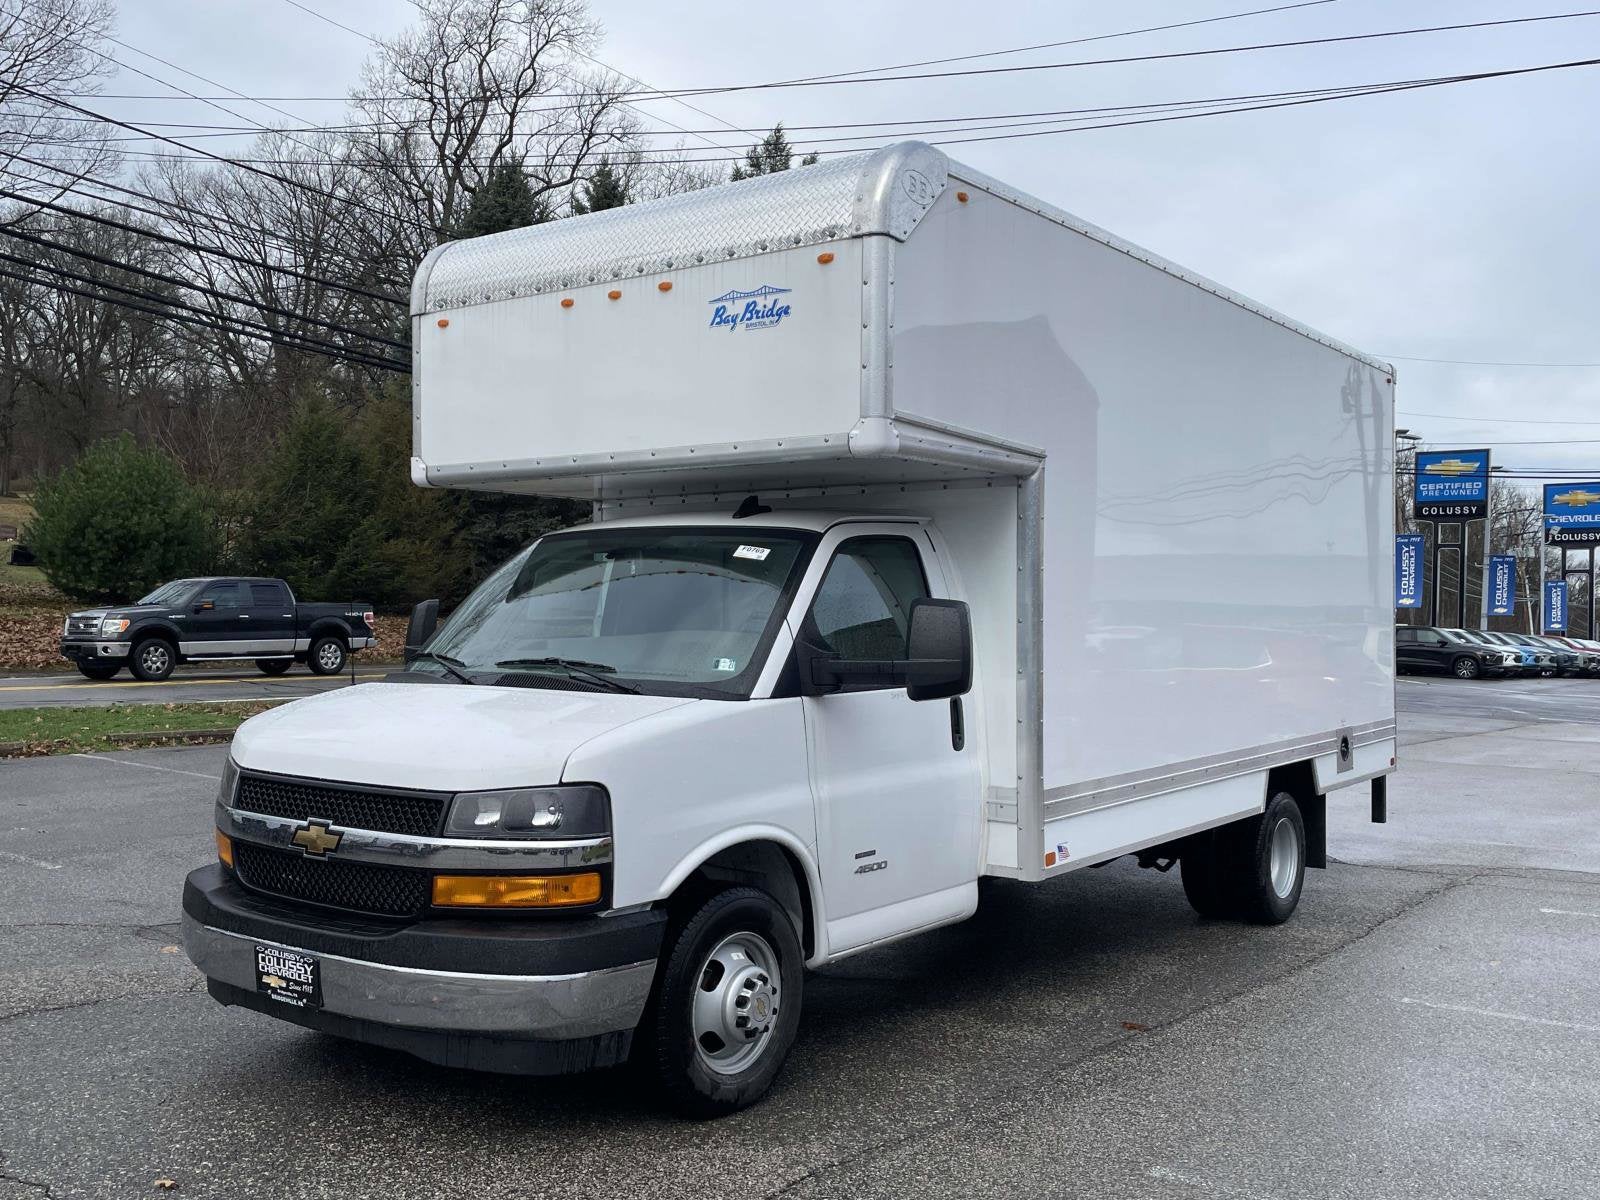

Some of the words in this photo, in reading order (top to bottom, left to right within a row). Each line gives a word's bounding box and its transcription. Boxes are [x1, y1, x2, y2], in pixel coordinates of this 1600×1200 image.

[710, 305, 739, 331] Bay
[739, 298, 790, 324] Bridge
[1420, 482, 1482, 490] CERTIFIED
[1422, 489, 1479, 497] PRE-OWNED
[1422, 506, 1477, 515] COLUSSY
[1554, 533, 1600, 541] COLUSSY
[1401, 545, 1410, 595] COLUSSY
[1495, 563, 1503, 606] COLUSSY
[267, 948, 301, 962] COLUSSY
[258, 953, 314, 976] COLUSSY
[259, 963, 314, 984] CHEVROLET
